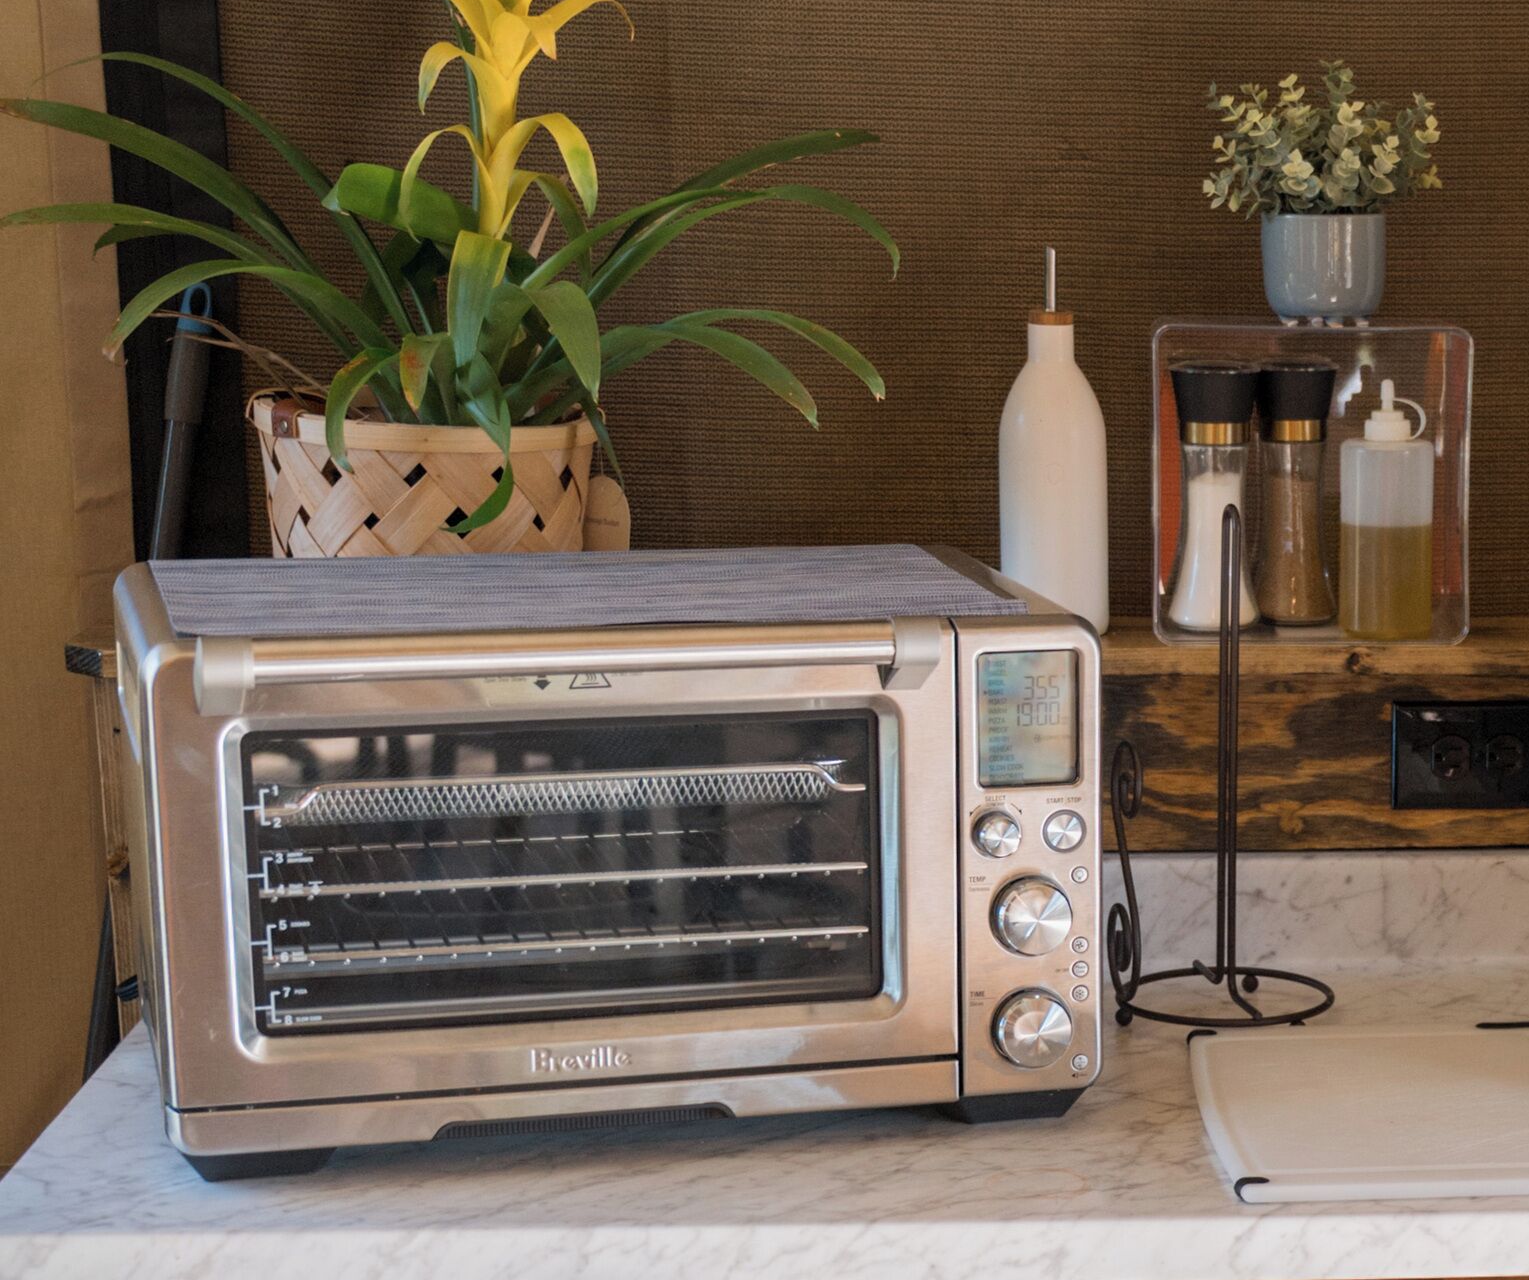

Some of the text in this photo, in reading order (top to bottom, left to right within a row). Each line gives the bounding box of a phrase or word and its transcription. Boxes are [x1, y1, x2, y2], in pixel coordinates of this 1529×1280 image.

[272, 785, 279, 796] 1
[273, 817, 282, 828] 2
[275, 853, 284, 864] 3
[279, 920, 288, 931] 5
[280, 952, 289, 963] 6
[282, 987, 291, 998] 7
[284, 1015, 293, 1025] 8
[530, 1045, 632, 1073] Breville
